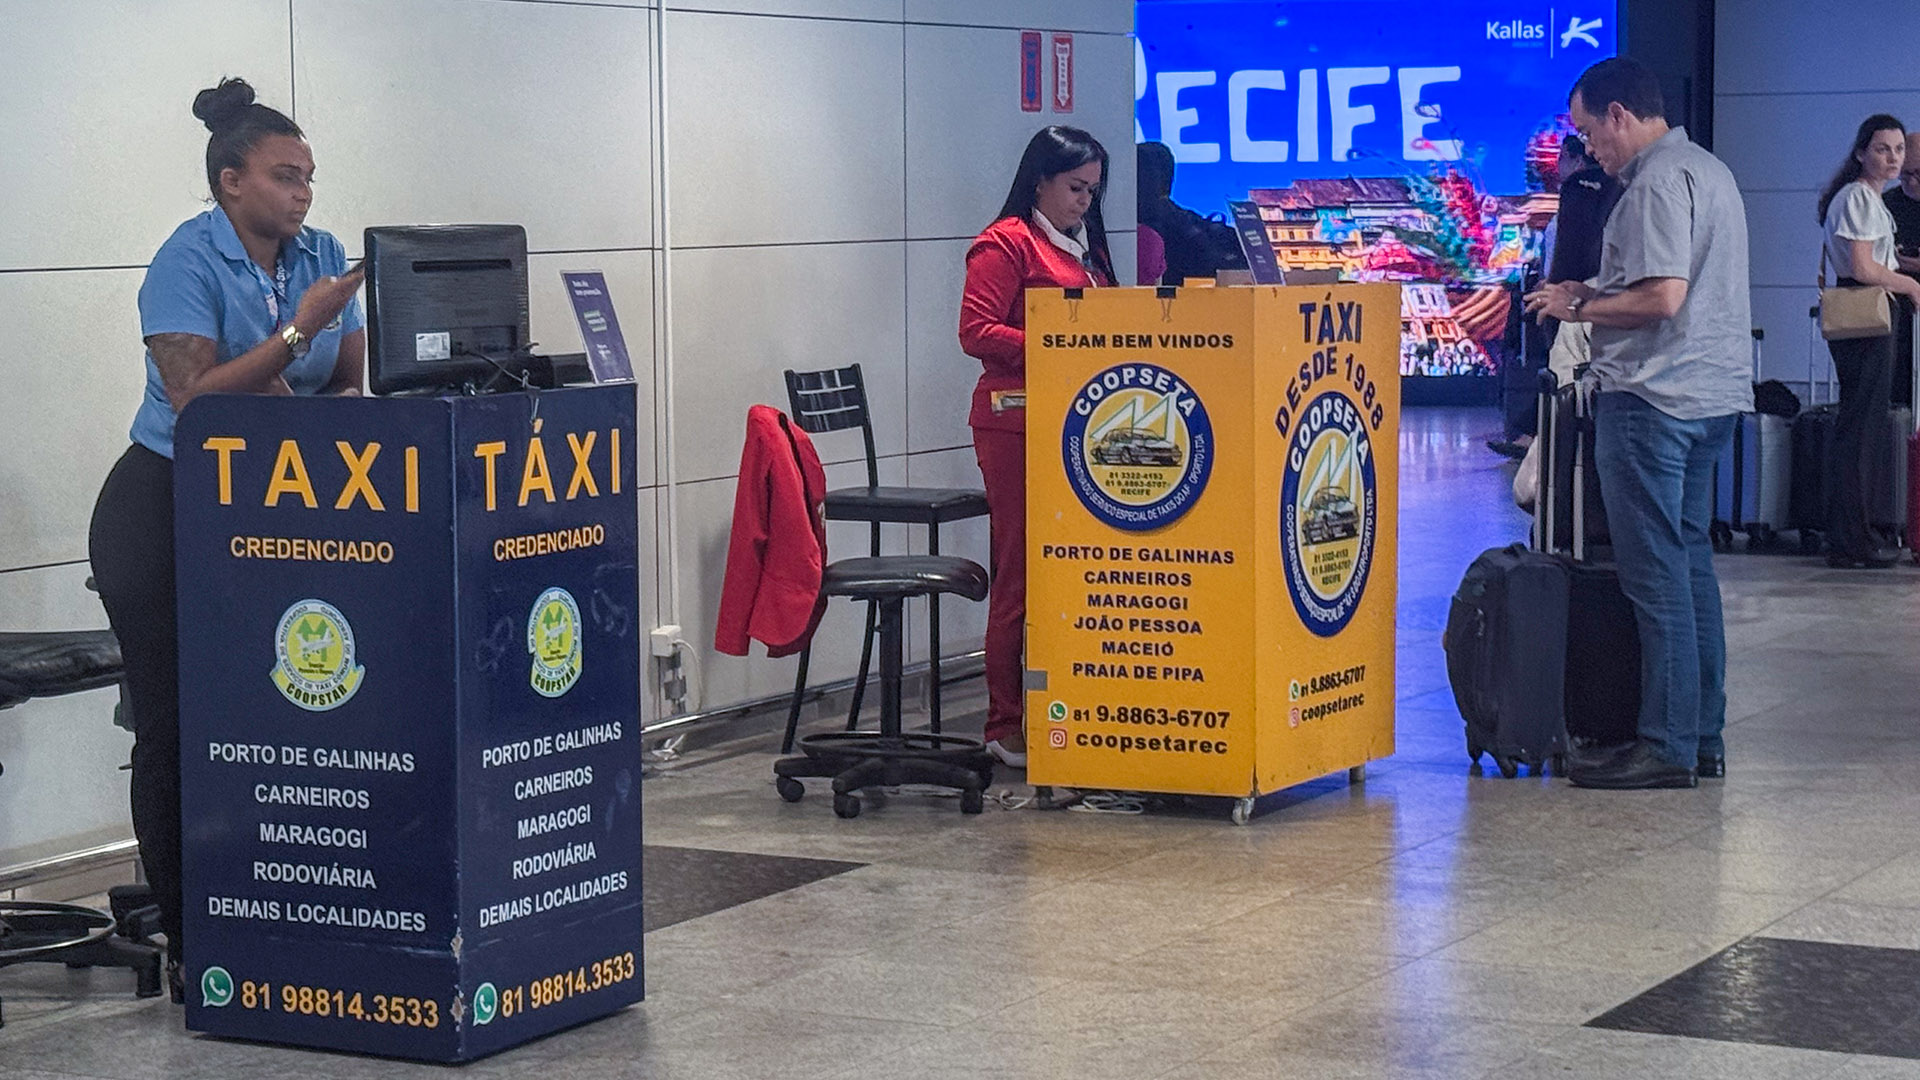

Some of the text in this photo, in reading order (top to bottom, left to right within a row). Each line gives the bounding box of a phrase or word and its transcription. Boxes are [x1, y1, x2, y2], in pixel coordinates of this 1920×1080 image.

[1486, 20, 1544, 39] Kallas
[1136, 40, 1463, 163] ECIFE
[1299, 292, 1362, 345] TÁXI
[1042, 334, 1234, 349] SEJAM BEM VINDOS
[1075, 367, 1196, 417] COOPSETA
[1275, 346, 1383, 439] DESDE 1988
[1291, 398, 1369, 473] COOPSETA
[203, 437, 420, 513] TAXI
[474, 418, 622, 512] TÁXI
[1121, 488, 1151, 496] RECIFE
[231, 536, 394, 564] CREDENCIADO
[494, 524, 605, 562] CREDENCIADO
[1043, 545, 1234, 565] PORTO DE GALINHAS
[1084, 570, 1192, 587] CARNEIROS
[1087, 593, 1188, 611] MARAGOGI
[1073, 615, 1203, 634] JOÃO PESSOA
[1101, 641, 1174, 657] MACEIÓ
[534, 666, 576, 692] COOPSTAR
[1072, 662, 1205, 683] PRAIA DE PIPA
[1301, 665, 1366, 697] 81 9.8863-6707
[286, 683, 348, 706] COOPSTAR
[1301, 691, 1365, 722] coopsetarec
[1073, 705, 1231, 729] 81 9.8863-6707
[209, 742, 415, 773] PORTO DE GALINHAS
[482, 721, 622, 769] PORTO DE GALINHAS
[1075, 731, 1228, 755] coopsetarec
[254, 783, 370, 809] CARNEIROS
[514, 765, 594, 801] CARNEIROS
[259, 822, 367, 849] MARAGOGI
[517, 804, 591, 840] MARAGOGI
[253, 861, 377, 890] RODOVIÁRIA
[512, 841, 596, 880] RODOVIÁRIA
[208, 896, 426, 932] DEMAIS LOCALIDADES
[479, 871, 628, 929] DEMAIS LOCALIDADES
[502, 952, 635, 1018] 81 98814.3533
[241, 981, 439, 1029] 81 98814.3533
